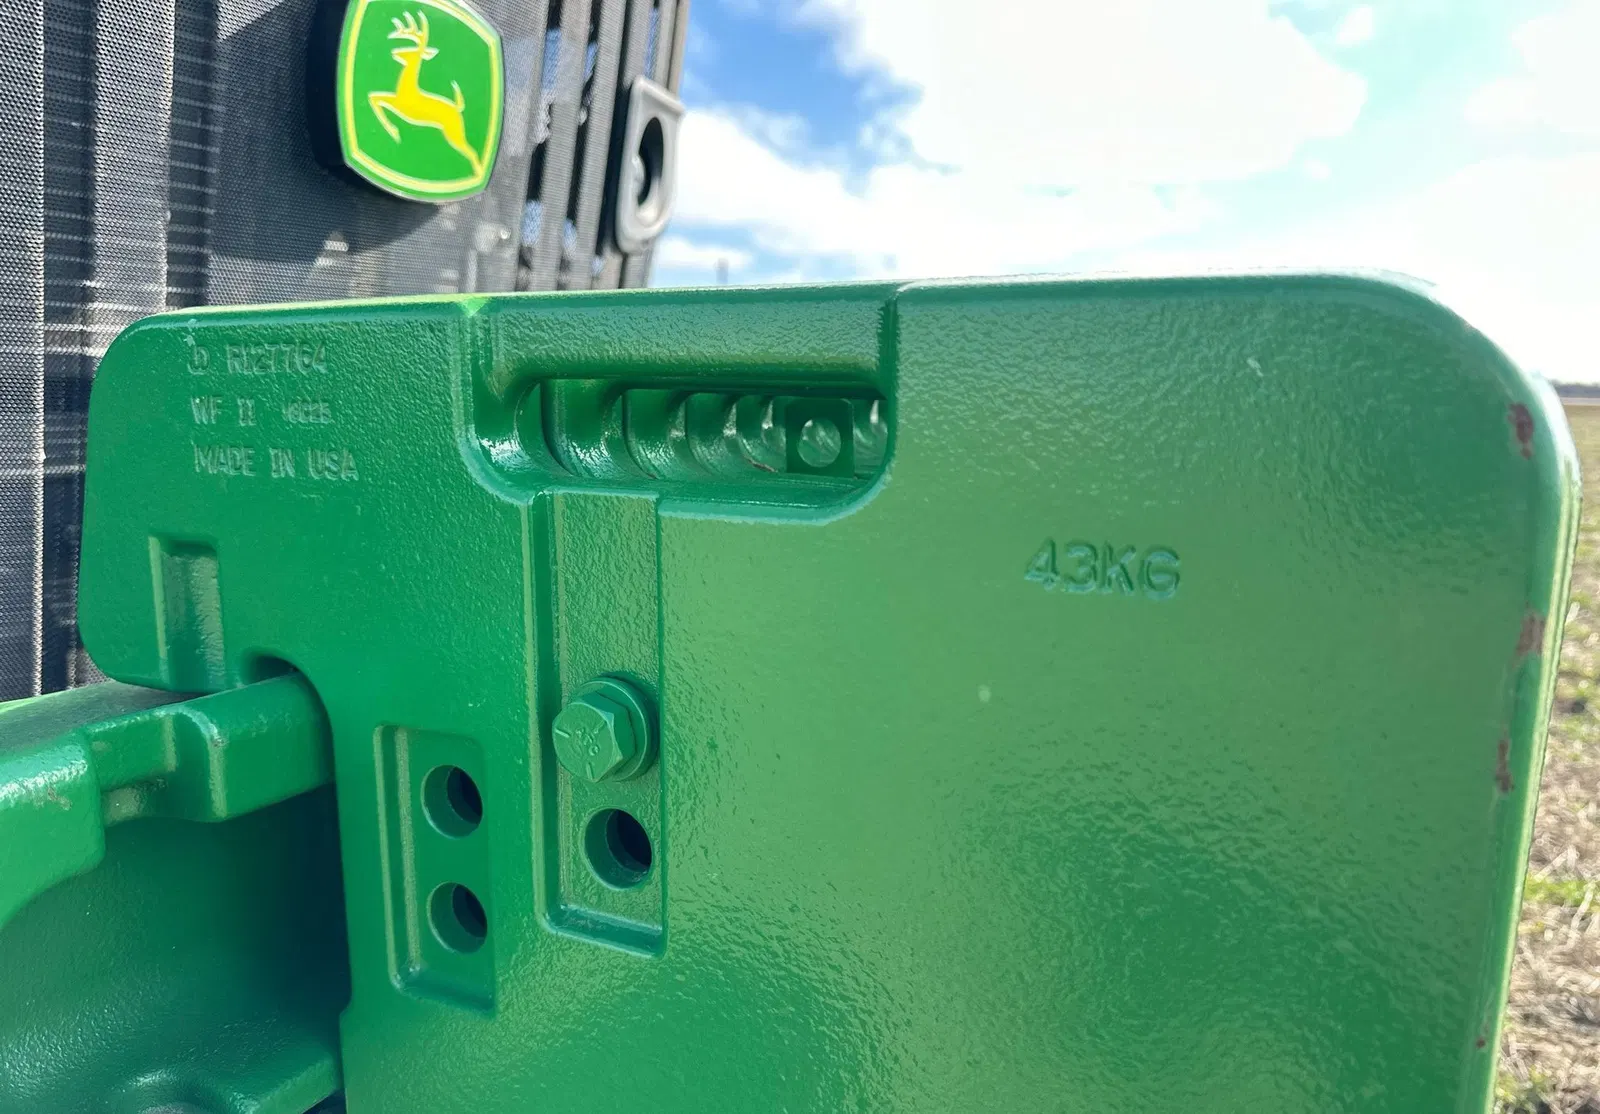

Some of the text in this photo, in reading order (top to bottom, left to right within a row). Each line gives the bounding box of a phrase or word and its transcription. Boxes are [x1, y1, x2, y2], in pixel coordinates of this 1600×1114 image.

[193, 445, 359, 481] MADE IN USA
[1024, 537, 1181, 600] 43KG
